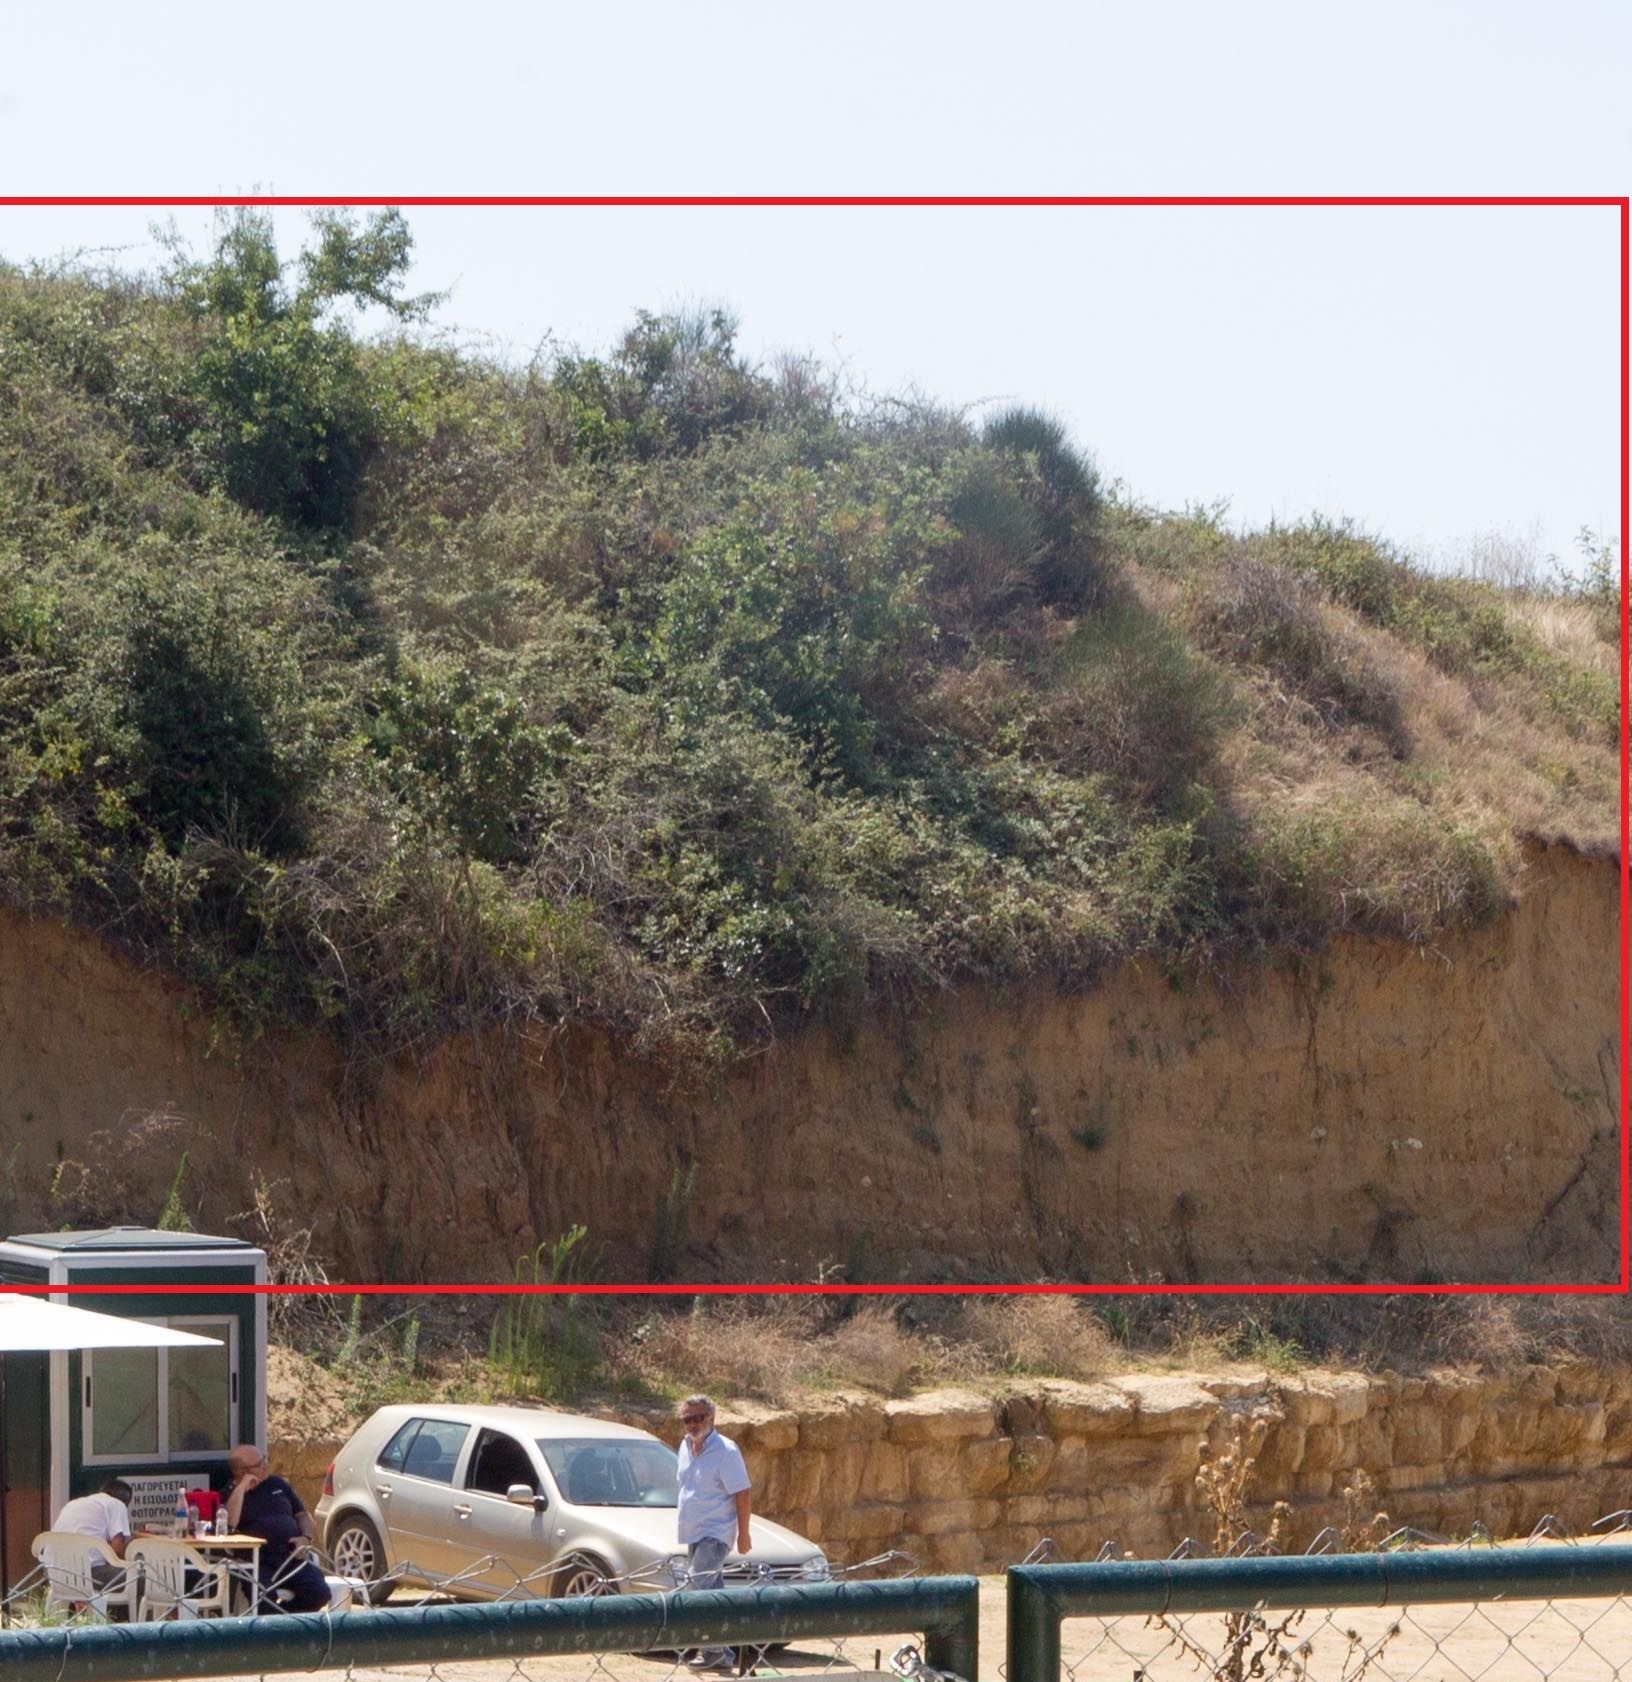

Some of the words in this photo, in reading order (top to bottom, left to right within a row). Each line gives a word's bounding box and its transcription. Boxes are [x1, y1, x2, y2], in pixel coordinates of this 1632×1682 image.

[131, 1480, 188, 1492] ΠΑΓΟΡΕΥΕΤΑΙ
[142, 1494, 179, 1505] ΕΙΣΟΔΟΣ
[131, 1507, 176, 1519] ΦΩΤΟΓΡΑΦ
